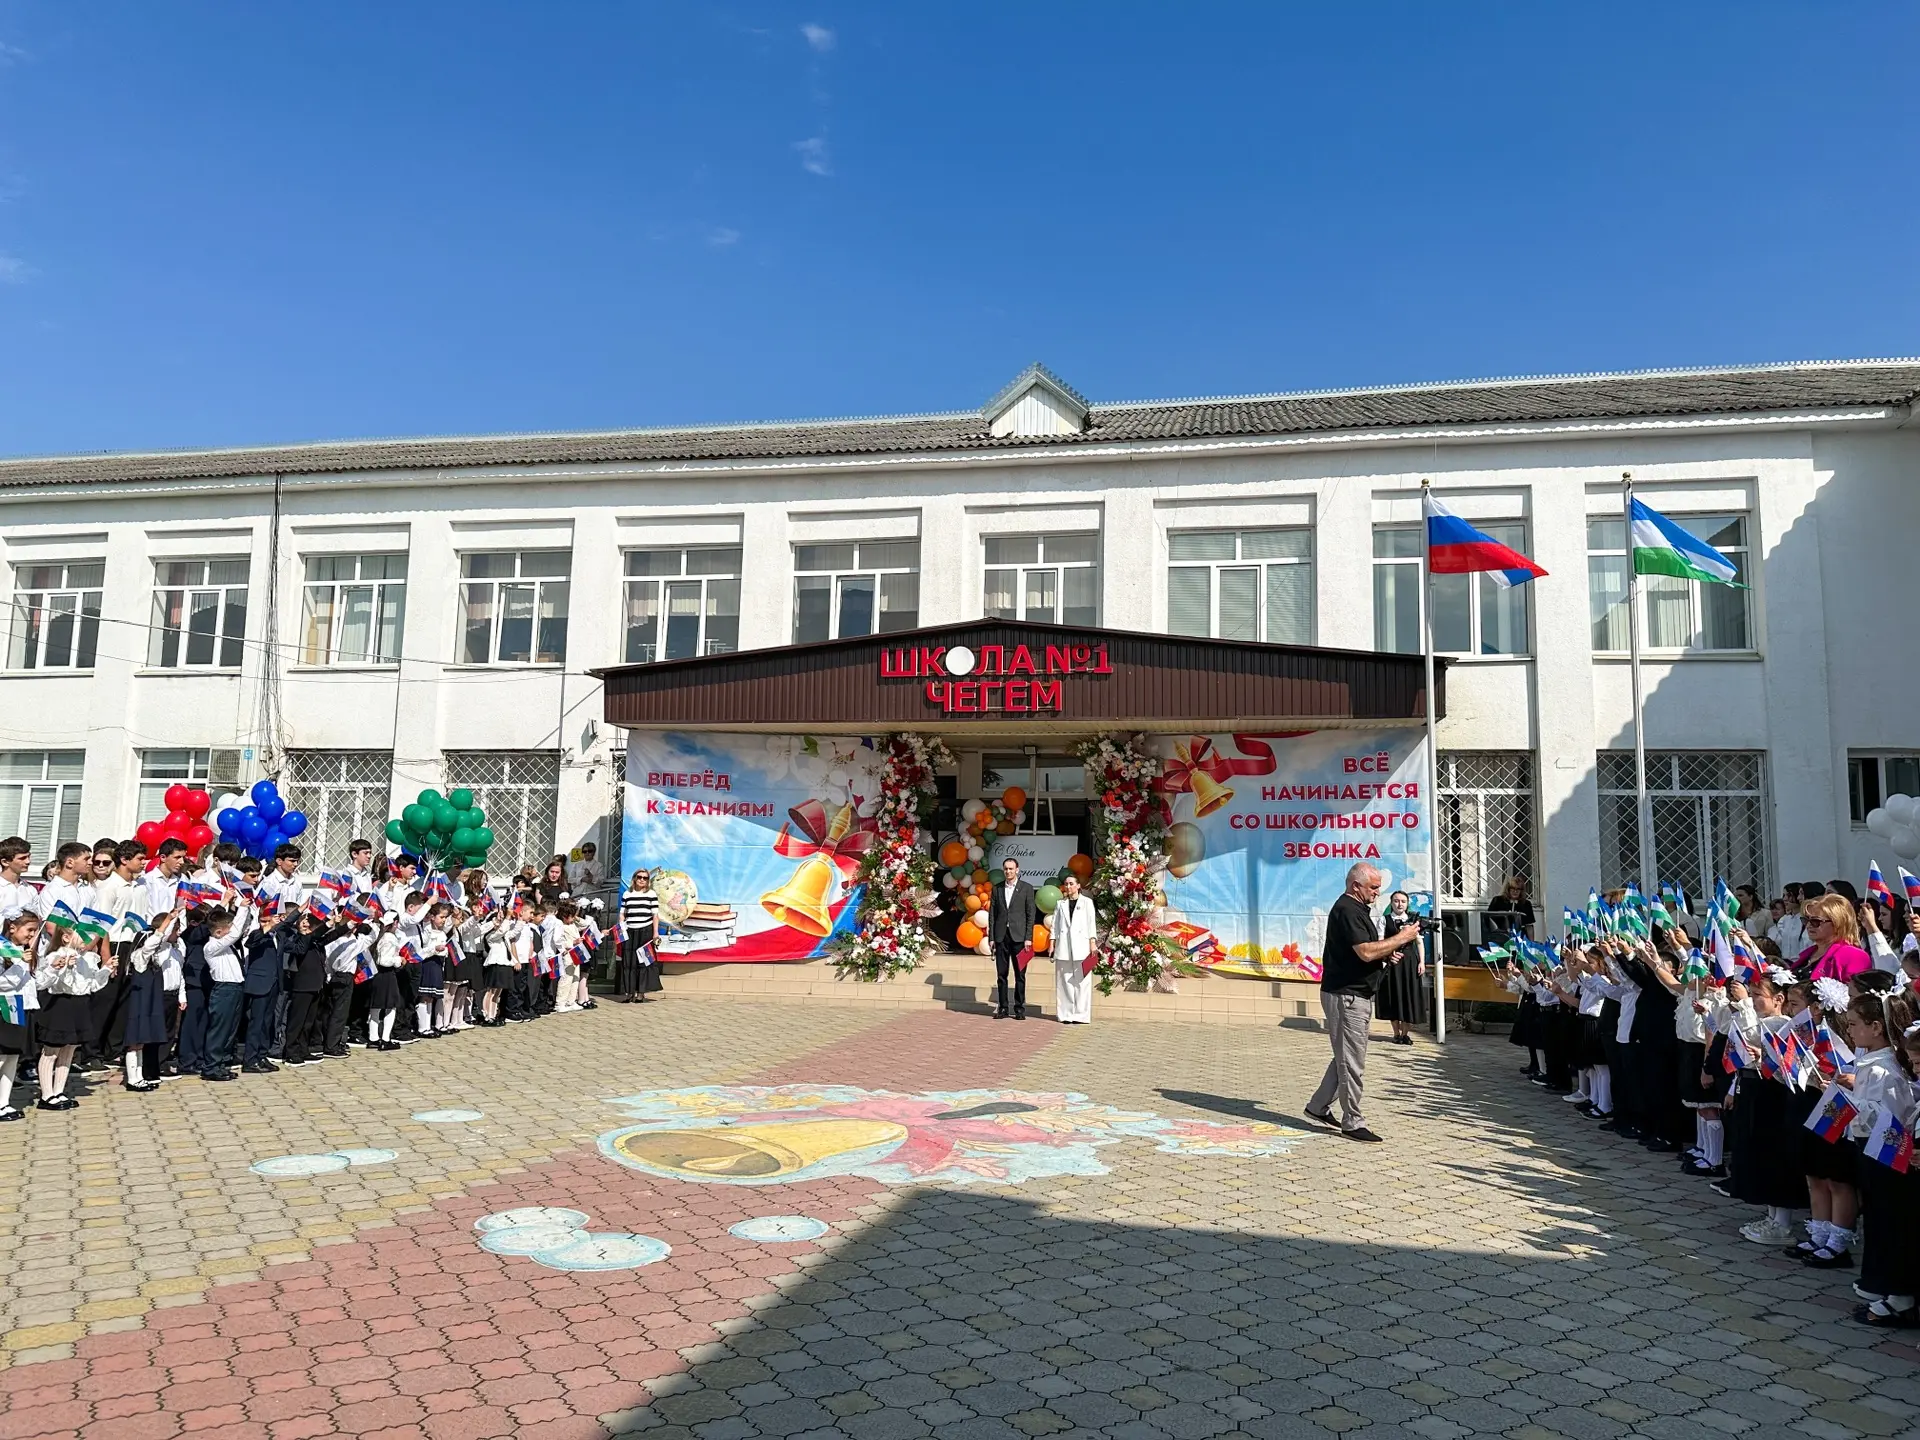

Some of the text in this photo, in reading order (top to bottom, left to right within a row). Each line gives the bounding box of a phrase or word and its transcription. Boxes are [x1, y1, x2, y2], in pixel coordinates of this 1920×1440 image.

[926, 681, 1062, 712] ЧЕГЕМ
[1343, 752, 1389, 774] ВСЁ
[648, 769, 731, 791] ВПЕРЁД
[1261, 782, 1419, 801] НАЧИНАЕТСЯ
[647, 800, 775, 817] К ЗНАНИЯМ!
[1229, 813, 1419, 830] СО ШКОЛЬНОГО
[1283, 842, 1381, 859] ЗВОНКА
